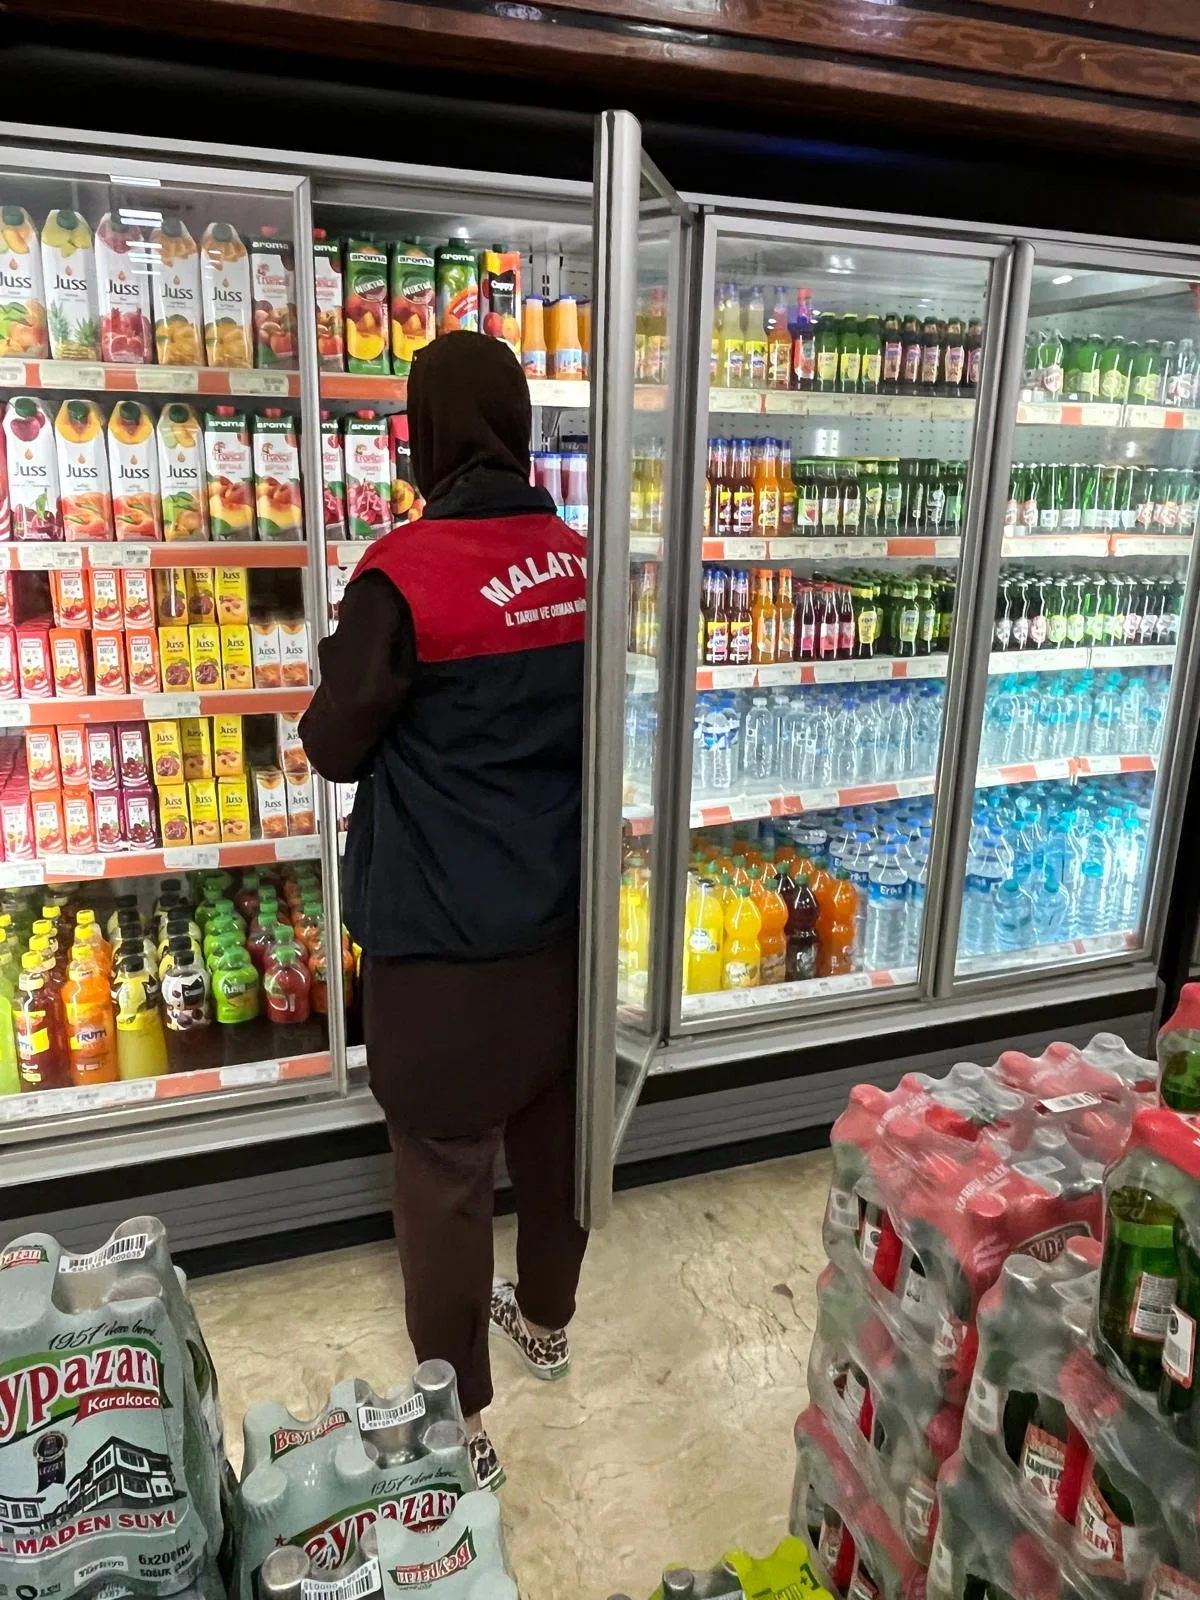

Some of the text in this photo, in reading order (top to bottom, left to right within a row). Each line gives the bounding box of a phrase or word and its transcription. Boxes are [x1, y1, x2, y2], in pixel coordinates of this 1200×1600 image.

[351, 253, 387, 263] aroma
[399, 256, 434, 266] aroma
[54, 275, 88, 291] Juss
[108, 280, 140, 296] Juss
[161, 284, 194, 300] Juss
[212, 287, 243, 303] Juss
[208, 420, 245, 428] aroma
[351, 423, 386, 431] aroma
[13, 462, 48, 478] Juss
[65, 463, 99, 479] Juss
[117, 464, 151, 480] Juss
[166, 464, 198, 479] Juss
[223, 571, 241, 580] Juss
[539, 606, 551, 620] VE
[166, 640, 185, 649] Juss
[196, 639, 215, 648] Juss
[227, 638, 245, 648] Juss
[259, 647, 276, 655] Juss
[285, 645, 304, 655] Juss
[220, 726, 238, 735] Juss
[156, 734, 174, 743] Juss
[165, 797, 183, 806] Juss
[195, 795, 213, 804] Juss
[226, 795, 243, 804] Juss
[264, 800, 282, 808] Juss
[292, 796, 310, 805] Juss
[0, 1347, 159, 1438] ypazarı
[88, 1391, 160, 1414] Karakoca
[15, 1513, 112, 1554] MADEN
[304, 1489, 458, 1573] eypazarı
